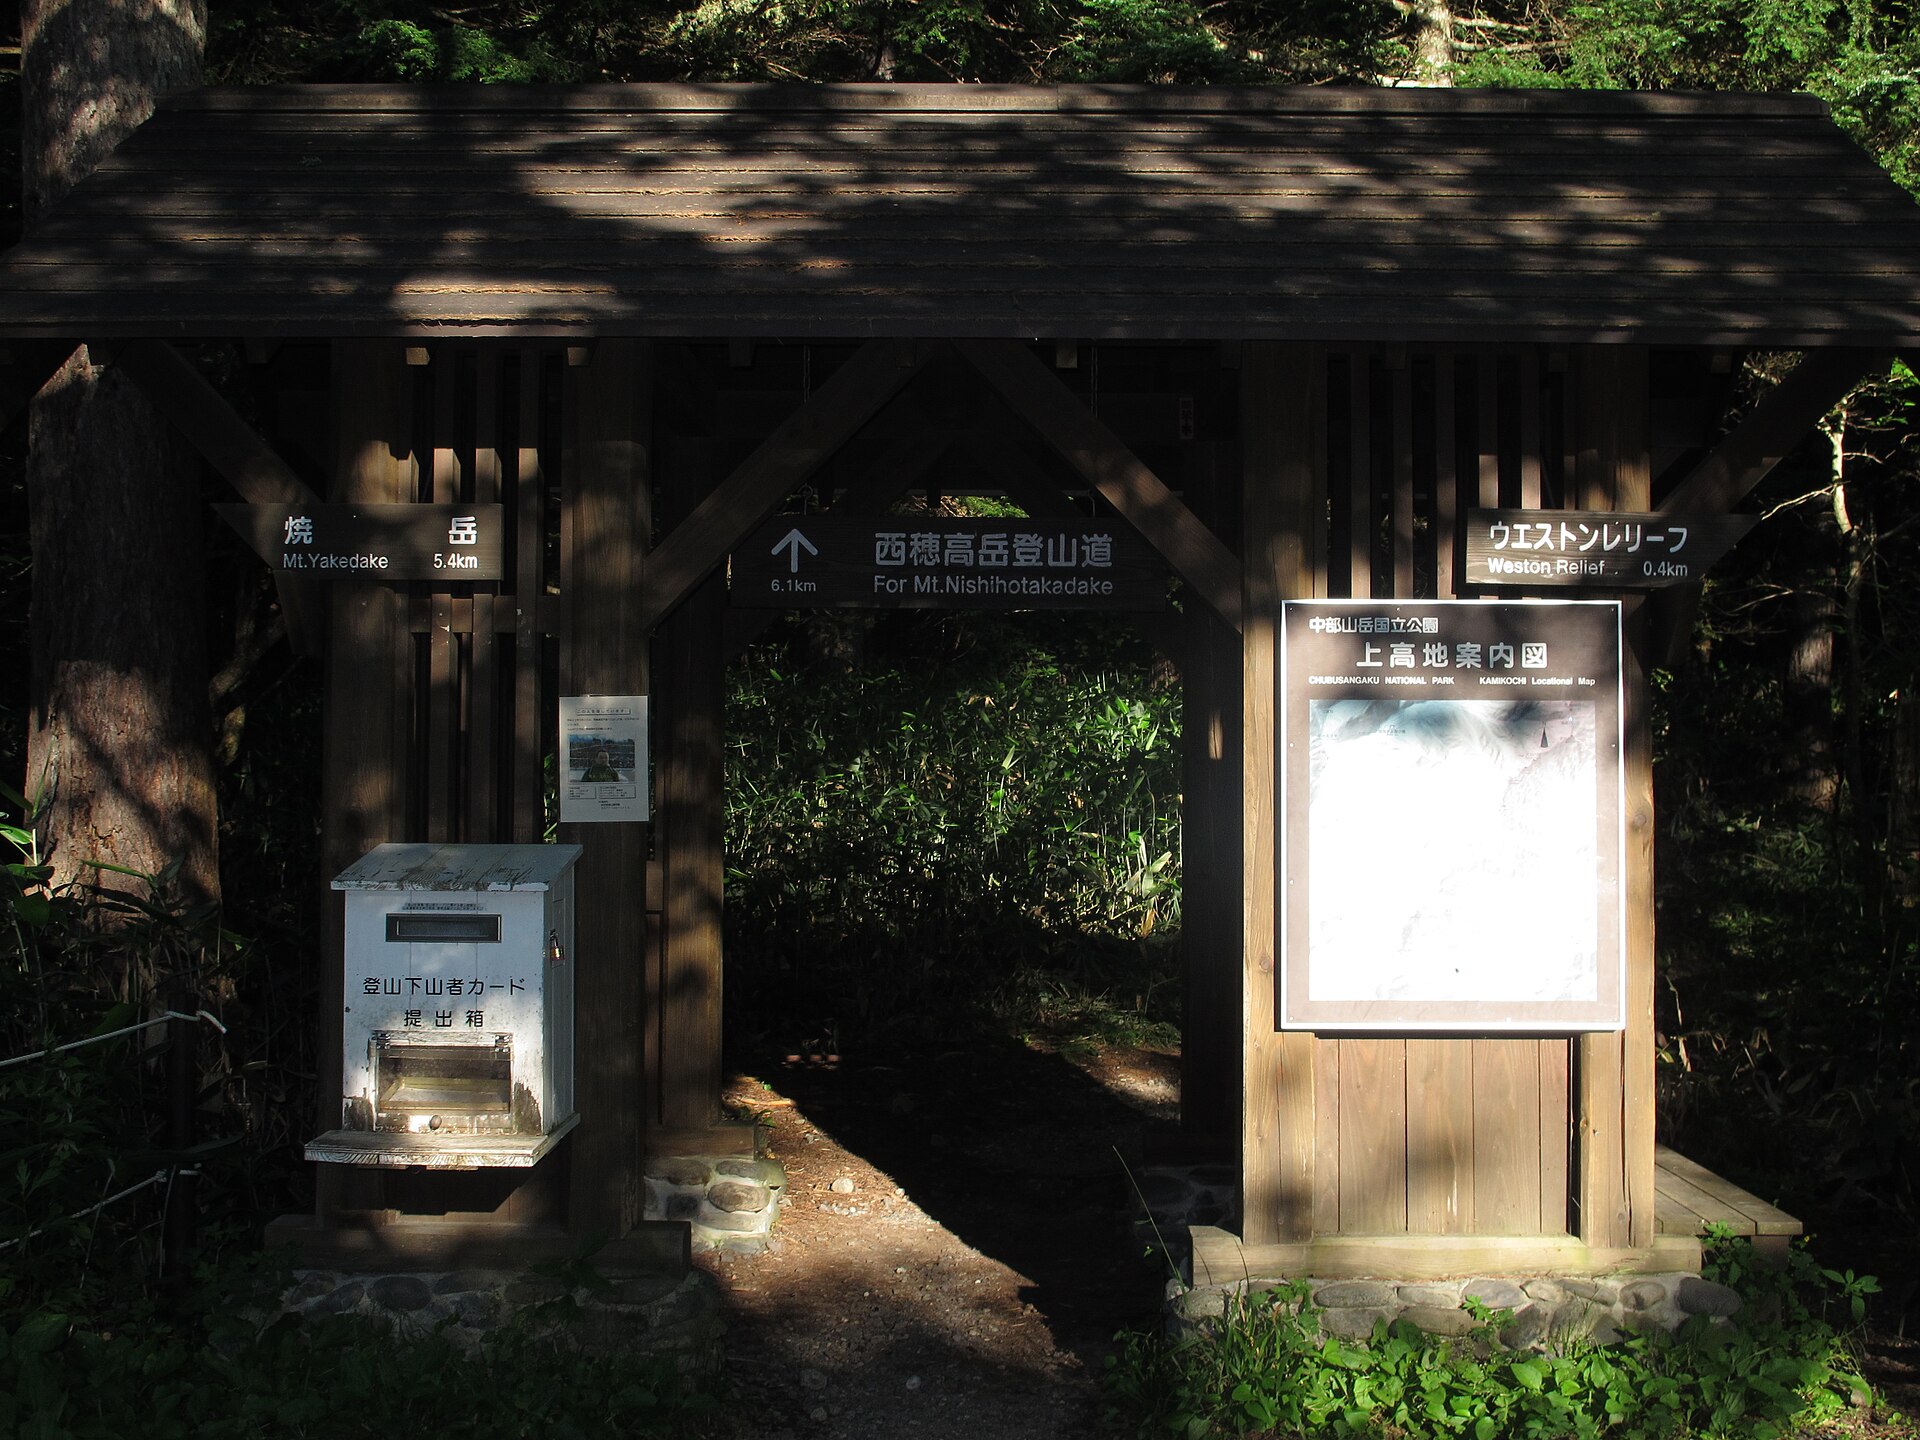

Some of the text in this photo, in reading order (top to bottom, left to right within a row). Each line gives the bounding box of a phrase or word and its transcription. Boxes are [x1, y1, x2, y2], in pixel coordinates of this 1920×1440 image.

[1489, 521, 1688, 553] ウエストンレリーフ
[875, 532, 1113, 568] 西穂高岳登山道
[283, 553, 478, 570] Mt.Yakedake 5.4km
[1488, 558, 1688, 577] Weston Relief 0.4km
[771, 579, 817, 593] 6.1km
[874, 575, 1113, 595] For Mt.Nishihotakadake
[1308, 617, 1439, 634] 中部山岳国立公園
[1356, 642, 1548, 669] 上高地案内図
[1308, 675, 1596, 687] CHUBUSANGAKU NATIONAL PARK KAMIKOCHI Locational Map
[362, 976, 525, 996] 登山下山者カード
[403, 1009, 484, 1028] 提出箱
